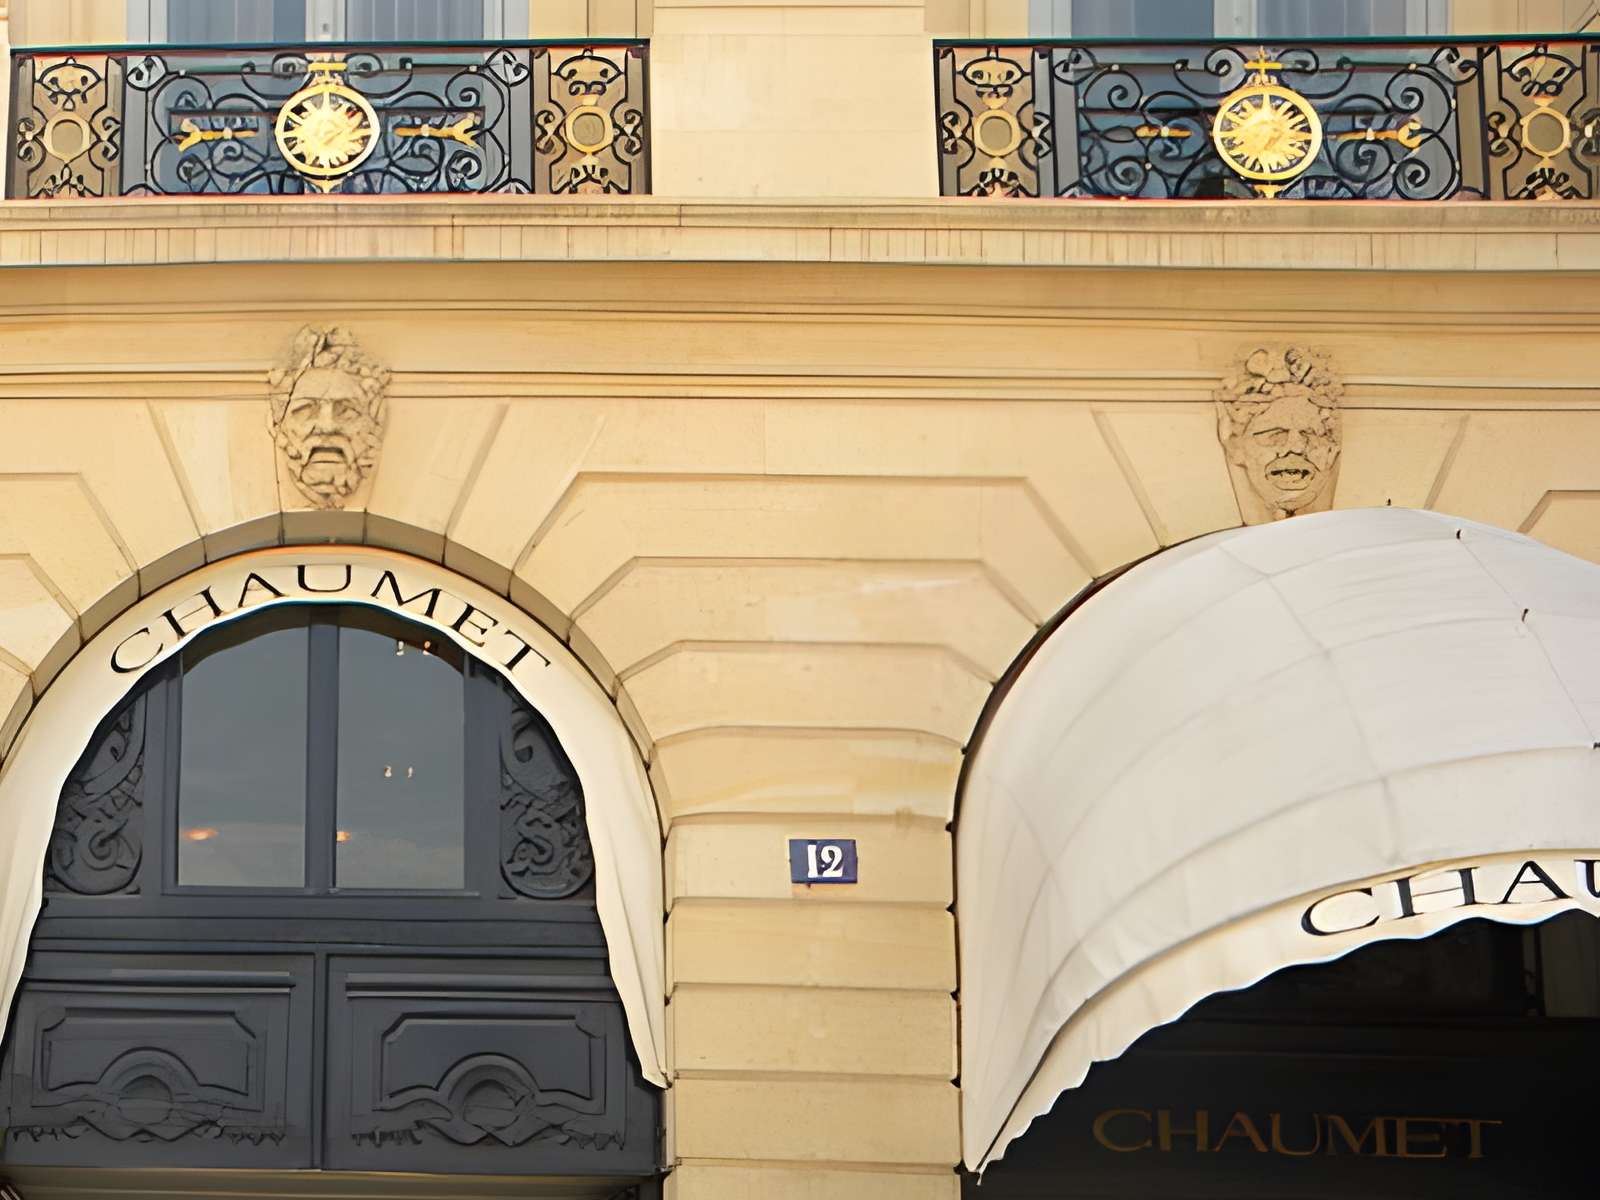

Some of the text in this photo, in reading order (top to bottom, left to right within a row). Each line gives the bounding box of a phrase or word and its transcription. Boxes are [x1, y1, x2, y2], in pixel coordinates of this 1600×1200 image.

[111, 564, 551, 674] CHAUMET
[807, 844, 843, 878] 12
[1092, 1108, 1503, 1159] CHAUMET
